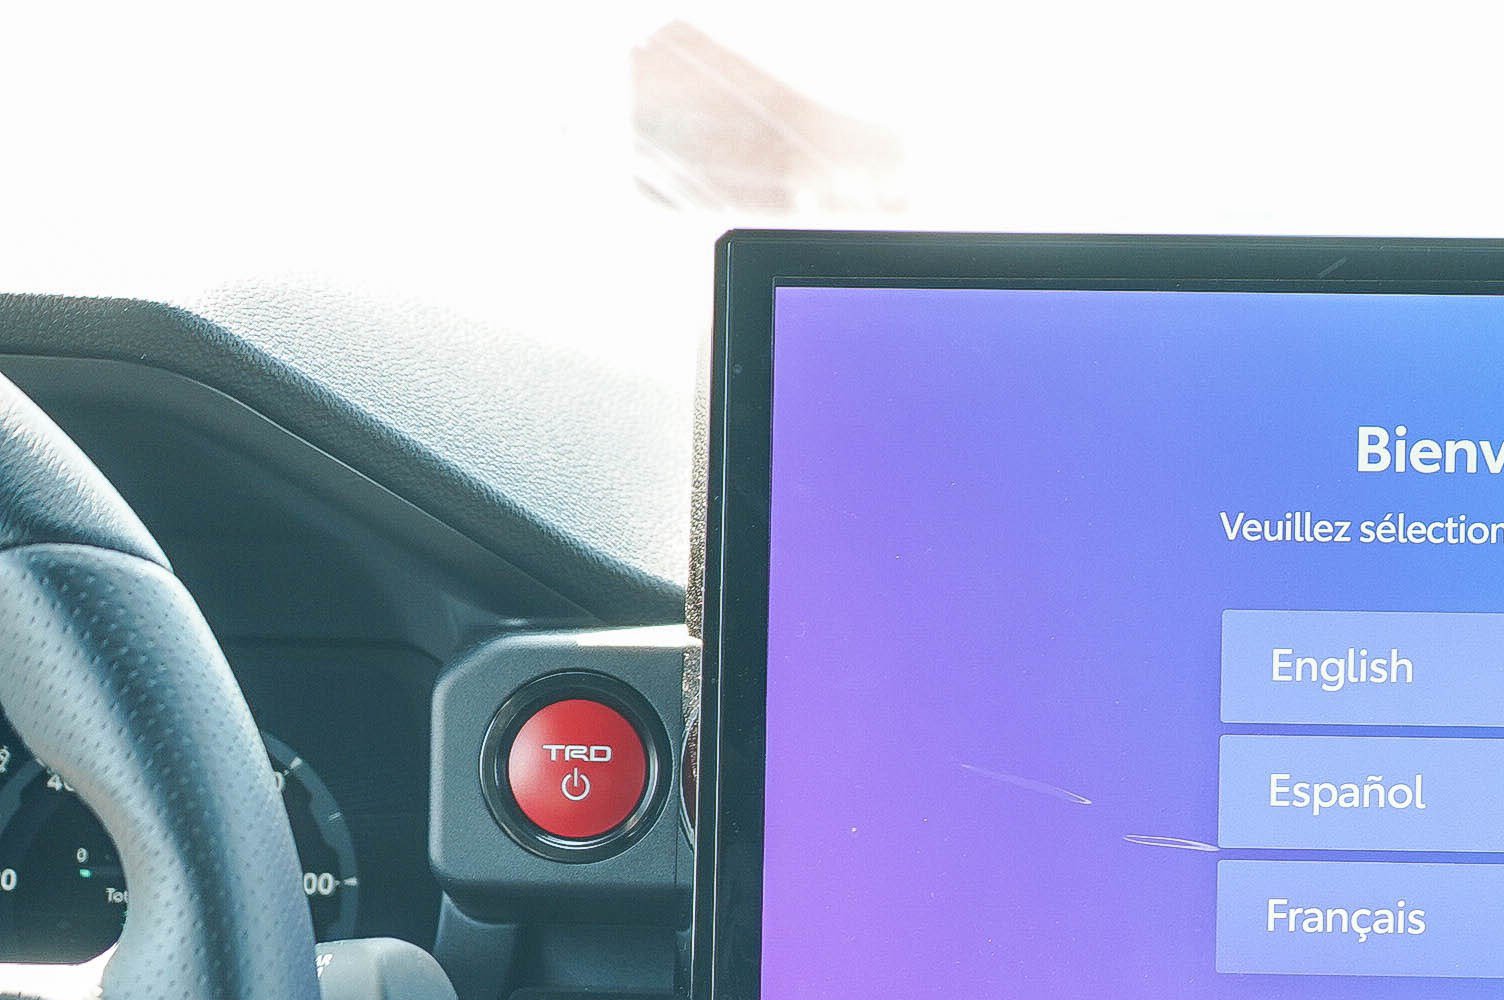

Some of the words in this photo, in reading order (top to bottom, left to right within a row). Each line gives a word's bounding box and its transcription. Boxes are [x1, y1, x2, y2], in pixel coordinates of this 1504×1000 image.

[1219, 511, 1352, 543] Veuillez
[1271, 647, 1414, 692] English
[541, 743, 613, 763] TRD
[1269, 772, 1427, 817] Español
[303, 872, 335, 896] 00
[1266, 897, 1427, 944] Français
